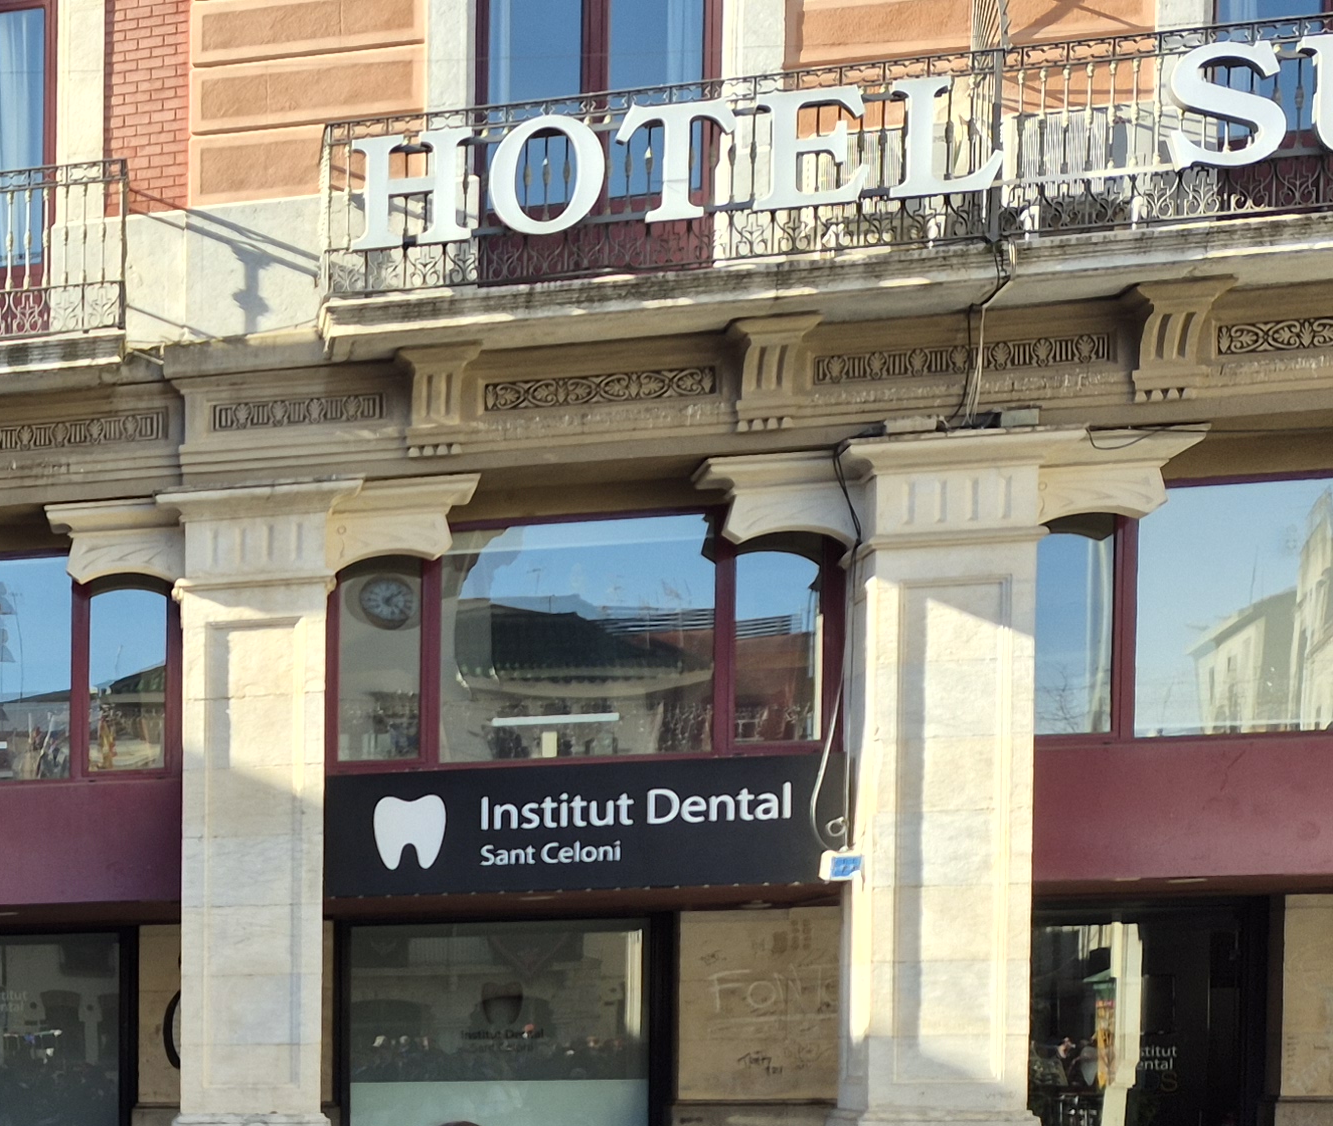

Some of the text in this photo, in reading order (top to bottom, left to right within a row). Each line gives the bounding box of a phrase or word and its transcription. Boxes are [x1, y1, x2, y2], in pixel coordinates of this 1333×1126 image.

[350, 75, 1003, 252] HOTEL
[480, 781, 792, 831] Institut Dental
[480, 840, 621, 866] Sant Celoni
[1137, 1057, 1173, 1070] ental
